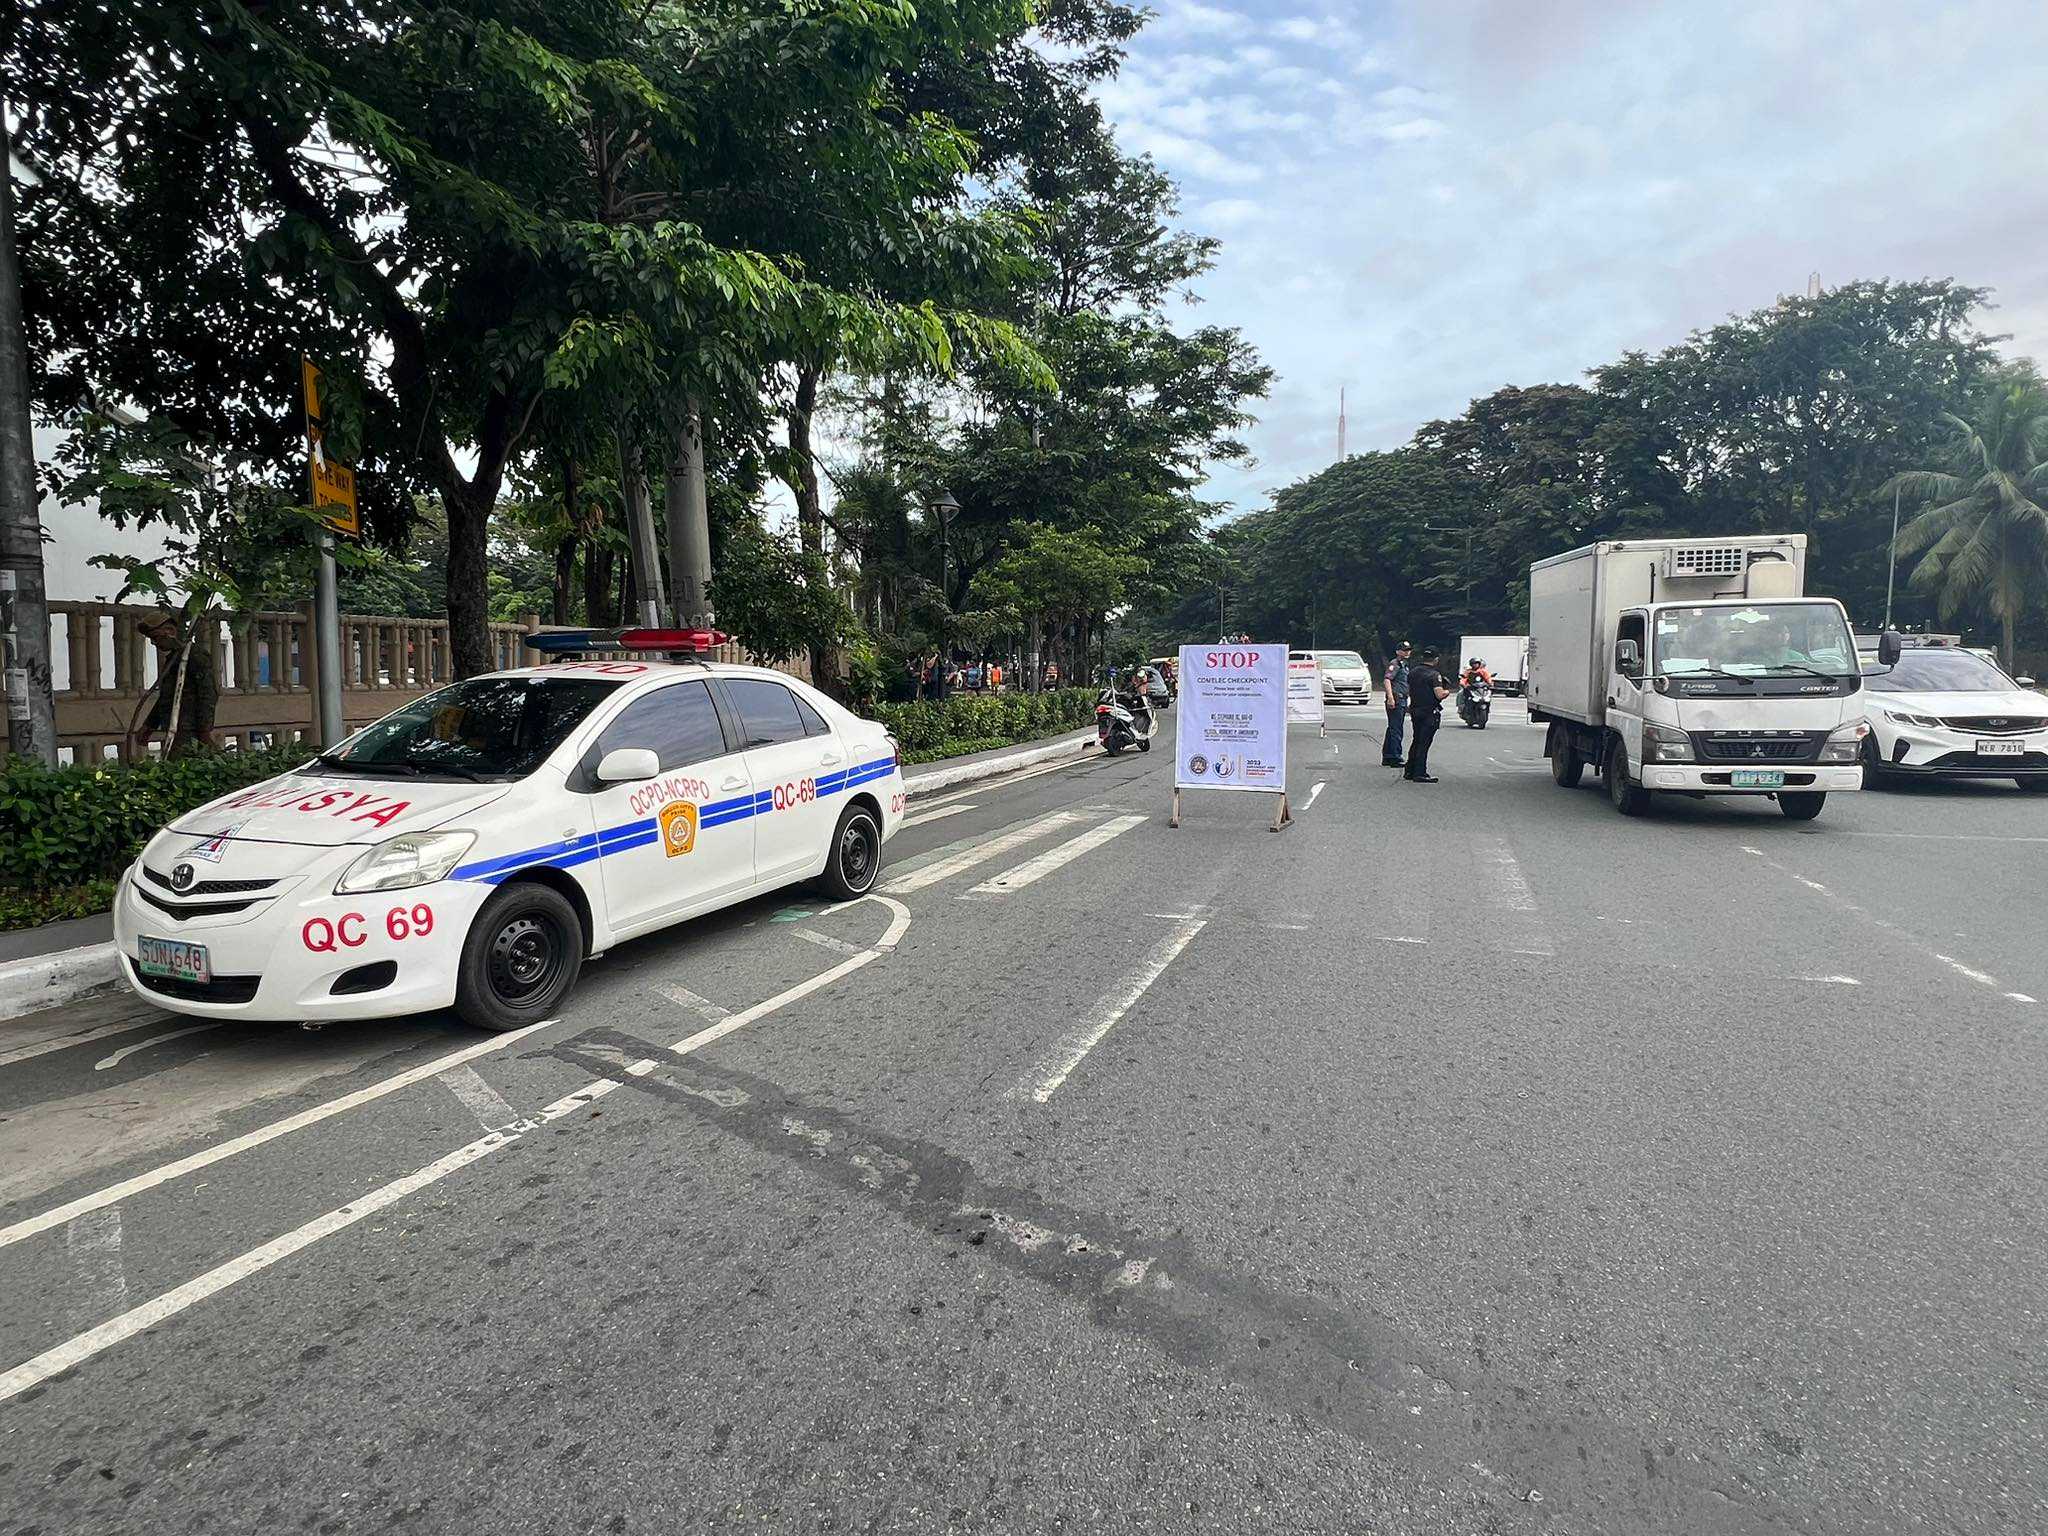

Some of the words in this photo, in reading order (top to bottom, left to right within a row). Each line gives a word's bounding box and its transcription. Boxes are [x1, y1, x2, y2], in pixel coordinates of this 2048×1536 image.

[1206, 652, 1260, 668] STOP
[630, 778, 710, 816] QCPD-NCRPO
[774, 778, 815, 810] QC-69
[302, 912, 368, 952] QC
[386, 903, 434, 940] 69
